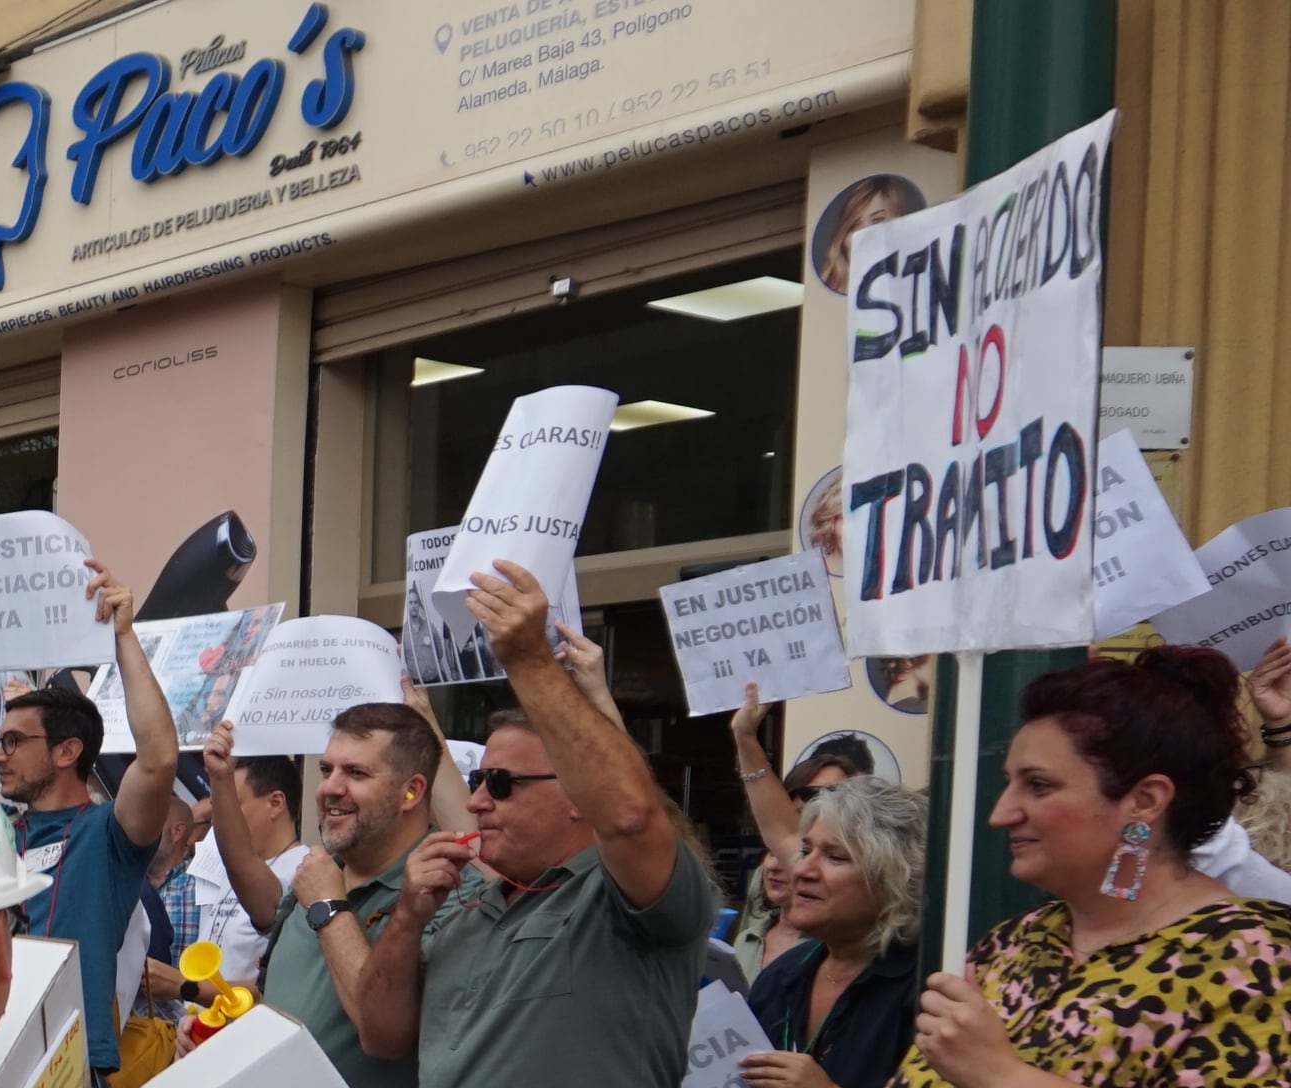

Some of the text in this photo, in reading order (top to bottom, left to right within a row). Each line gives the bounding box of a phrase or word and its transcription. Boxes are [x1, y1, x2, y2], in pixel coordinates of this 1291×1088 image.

[460, 4, 520, 37] VENTA
[460, 9, 587, 62] PELUQUERÍA,
[458, 69, 479, 88] C/
[481, 52, 533, 81] Marea
[538, 38, 575, 62] Baja
[580, 30, 607, 50] 43,
[613, 3, 693, 41] Polígono
[67, 2, 367, 206] Paco's
[457, 58, 605, 113] Alameda, Málaga.
[320, 131, 363, 161] 1964
[541, 87, 839, 184] www.pelucaspacos.com
[71, 164, 361, 264] ARTICULOS DE PELUQUERIA Y BELLEZA
[58, 292, 109, 319] BEAUTY
[112, 285, 139, 305] AND
[144, 252, 245, 294] HAIRDRESSING
[250, 231, 338, 266] PRODUCTS.
[853, 222, 968, 364] SIN
[951, 323, 1007, 448] NO
[1099, 406, 1150, 418] BOGADO
[523, 515, 580, 541] JUSTA
[414, 556, 446, 572] COMIT
[1206, 544, 1269, 586] CIONES
[675, 570, 816, 618] EN JUSTICIA
[323, 638, 339, 648] DE
[675, 602, 823, 650] NEGOCIACIÓN
[280, 656, 347, 668] EN HUELGA
[743, 648, 772, 668] YA
[263, 686, 288, 701] Sin
[239, 707, 347, 723] NO HAY JUST
[43, 844, 61, 856] SP
